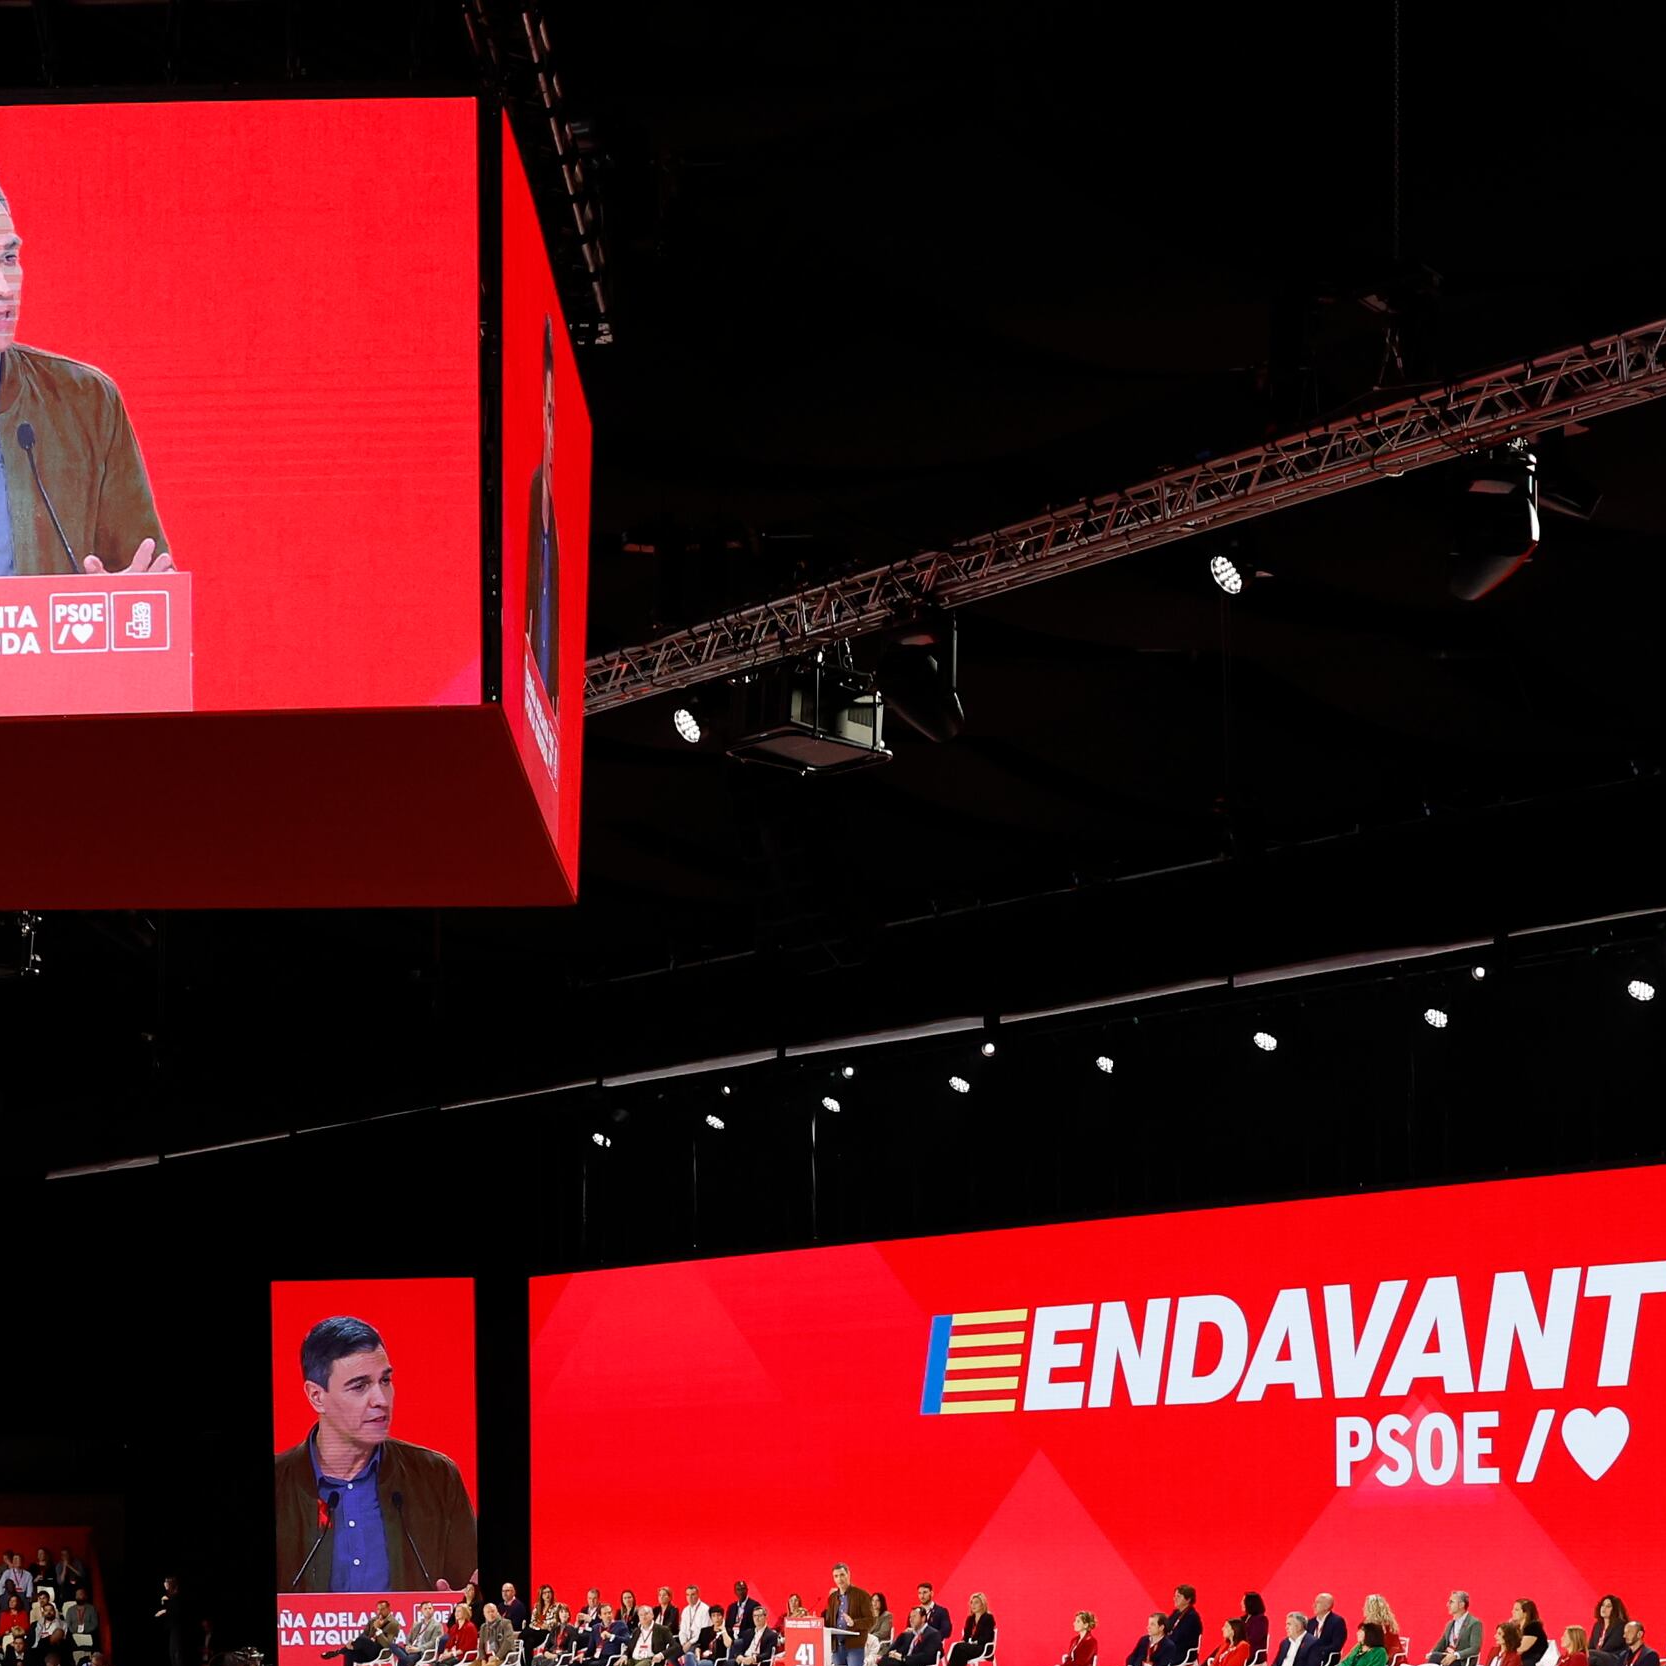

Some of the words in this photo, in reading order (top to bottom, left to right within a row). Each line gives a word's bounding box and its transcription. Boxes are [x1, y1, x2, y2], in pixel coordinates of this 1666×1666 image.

[55, 603, 104, 624] PSOE
[1335, 1411, 1500, 1488] PSOE
[277, 1609, 307, 1628] ÑA
[281, 1630, 304, 1646] LA
[795, 1643, 814, 1665] 41
